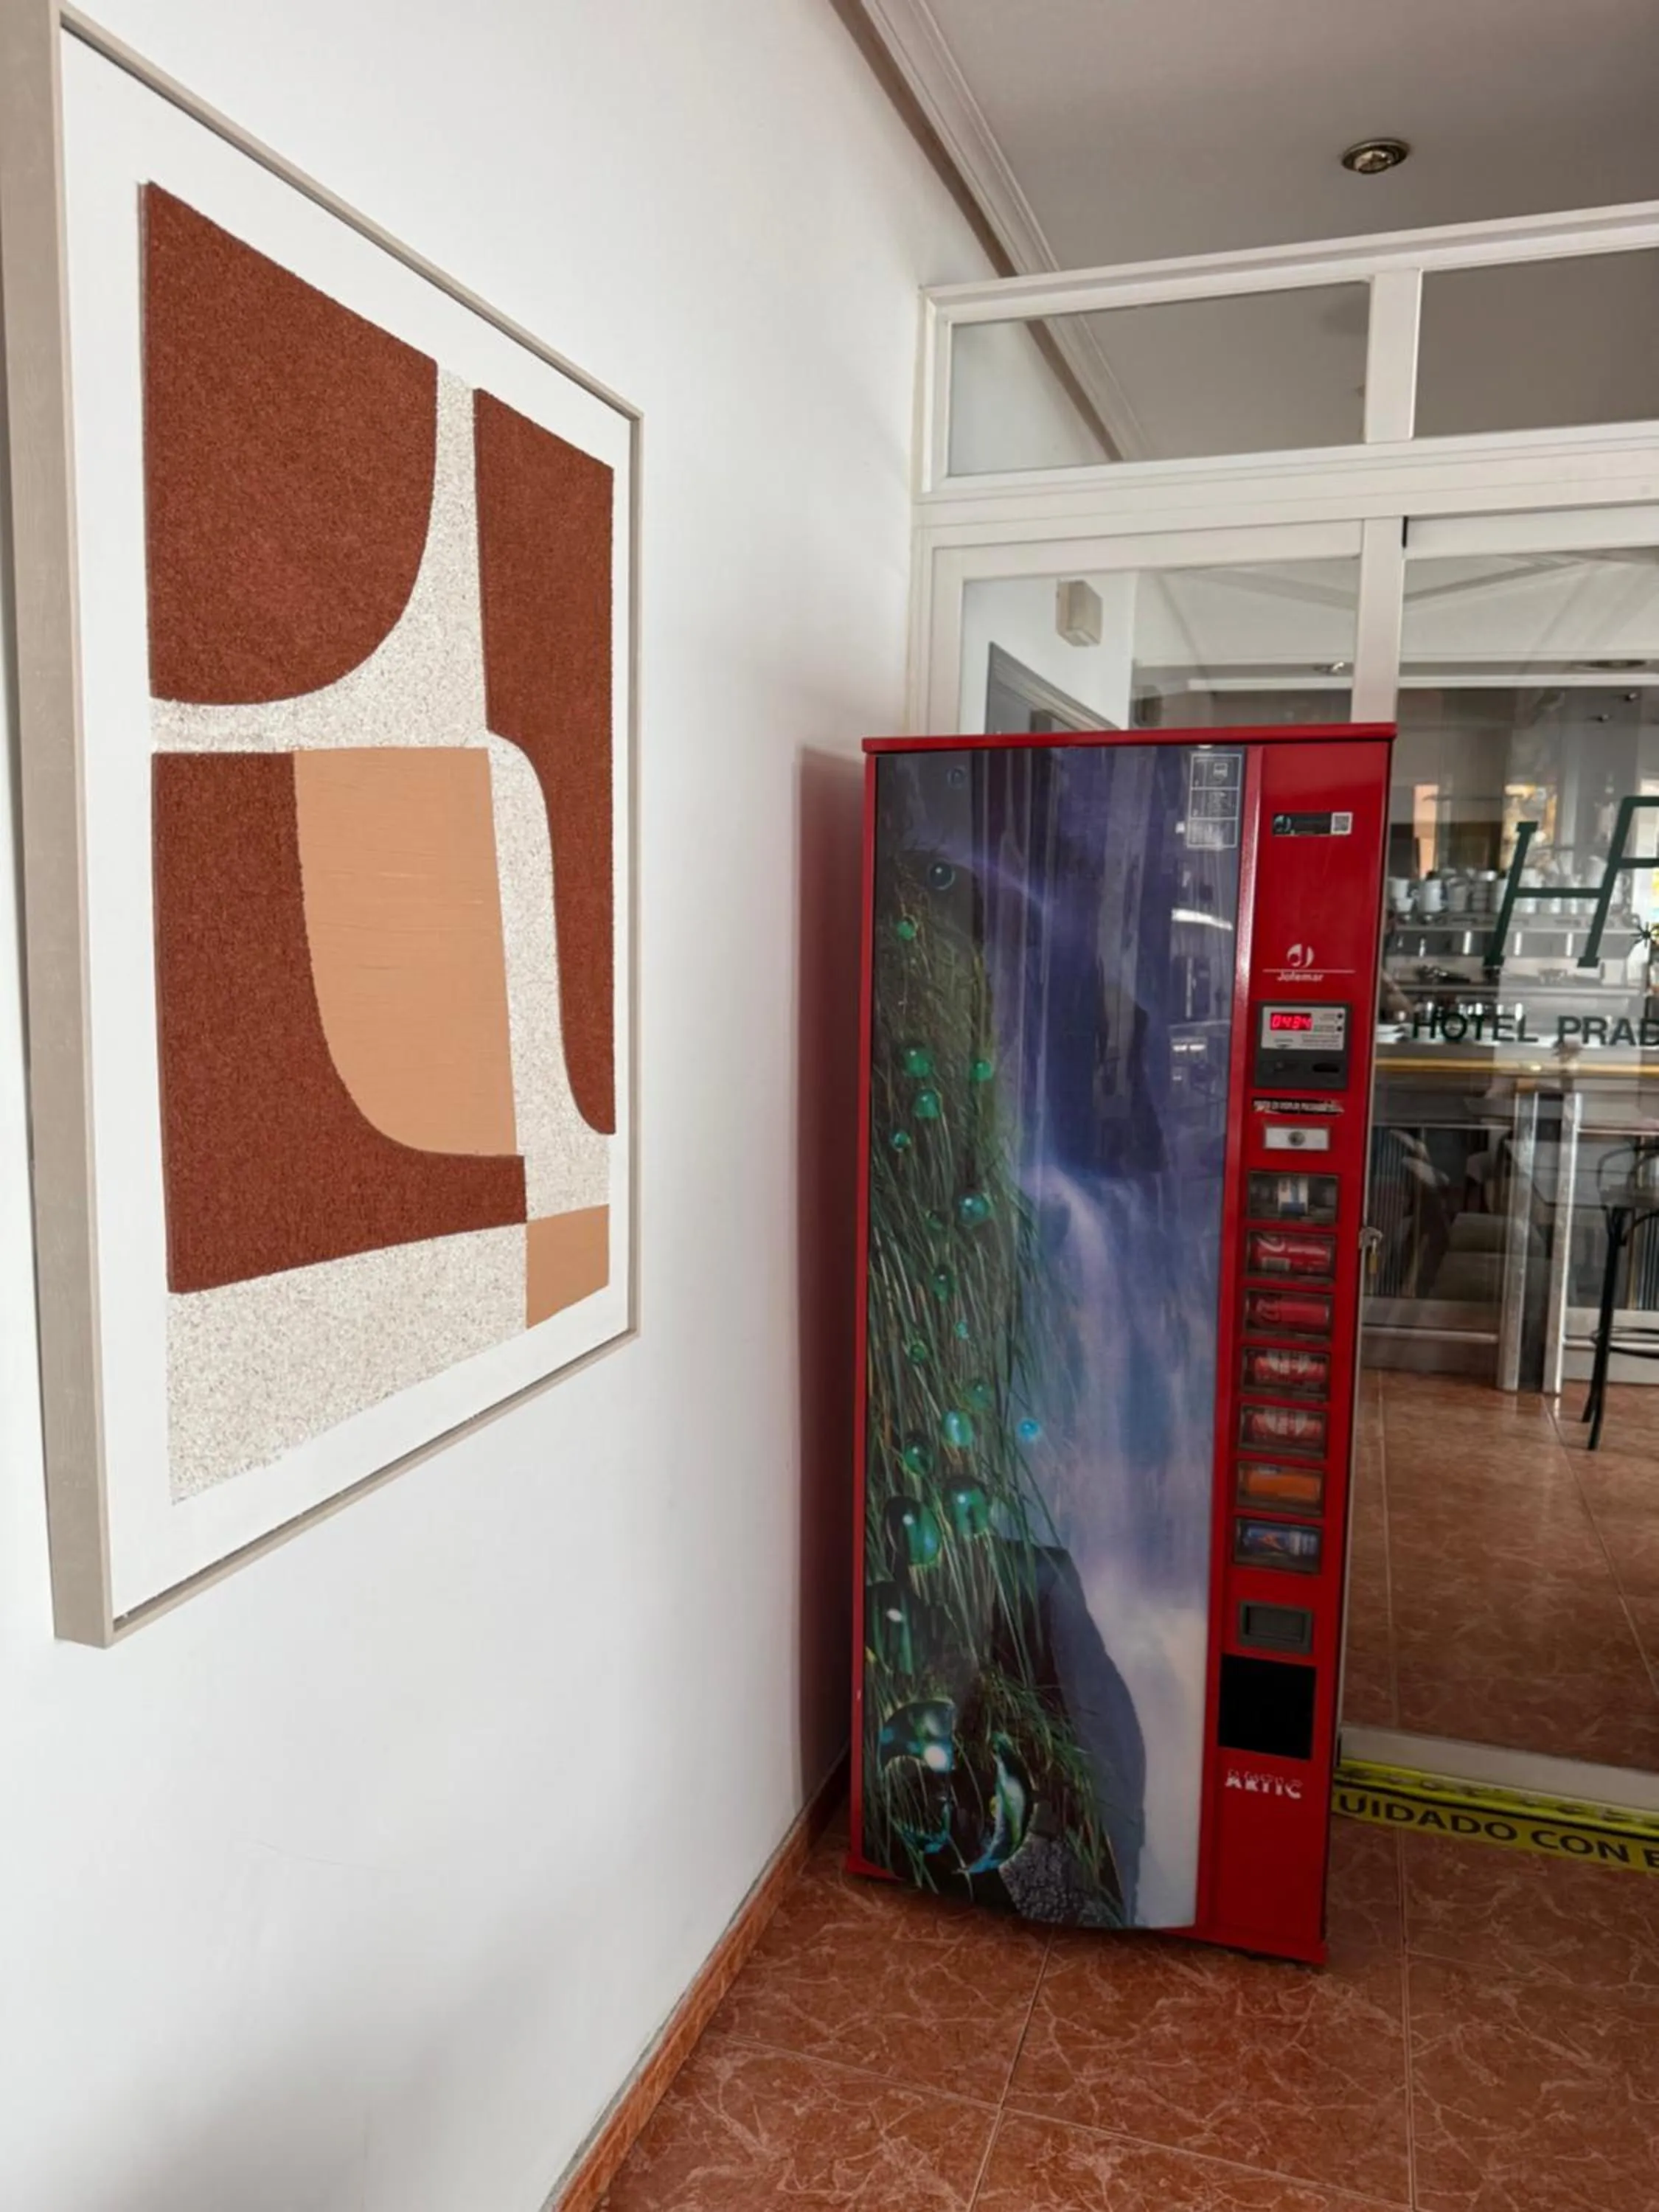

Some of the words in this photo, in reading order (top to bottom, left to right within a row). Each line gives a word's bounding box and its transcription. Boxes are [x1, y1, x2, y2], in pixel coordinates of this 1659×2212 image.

[1412, 1012, 1539, 1043] HOTEL
[1338, 1792, 1517, 1841] UIDADO
[1531, 1829, 1630, 1863] CON
